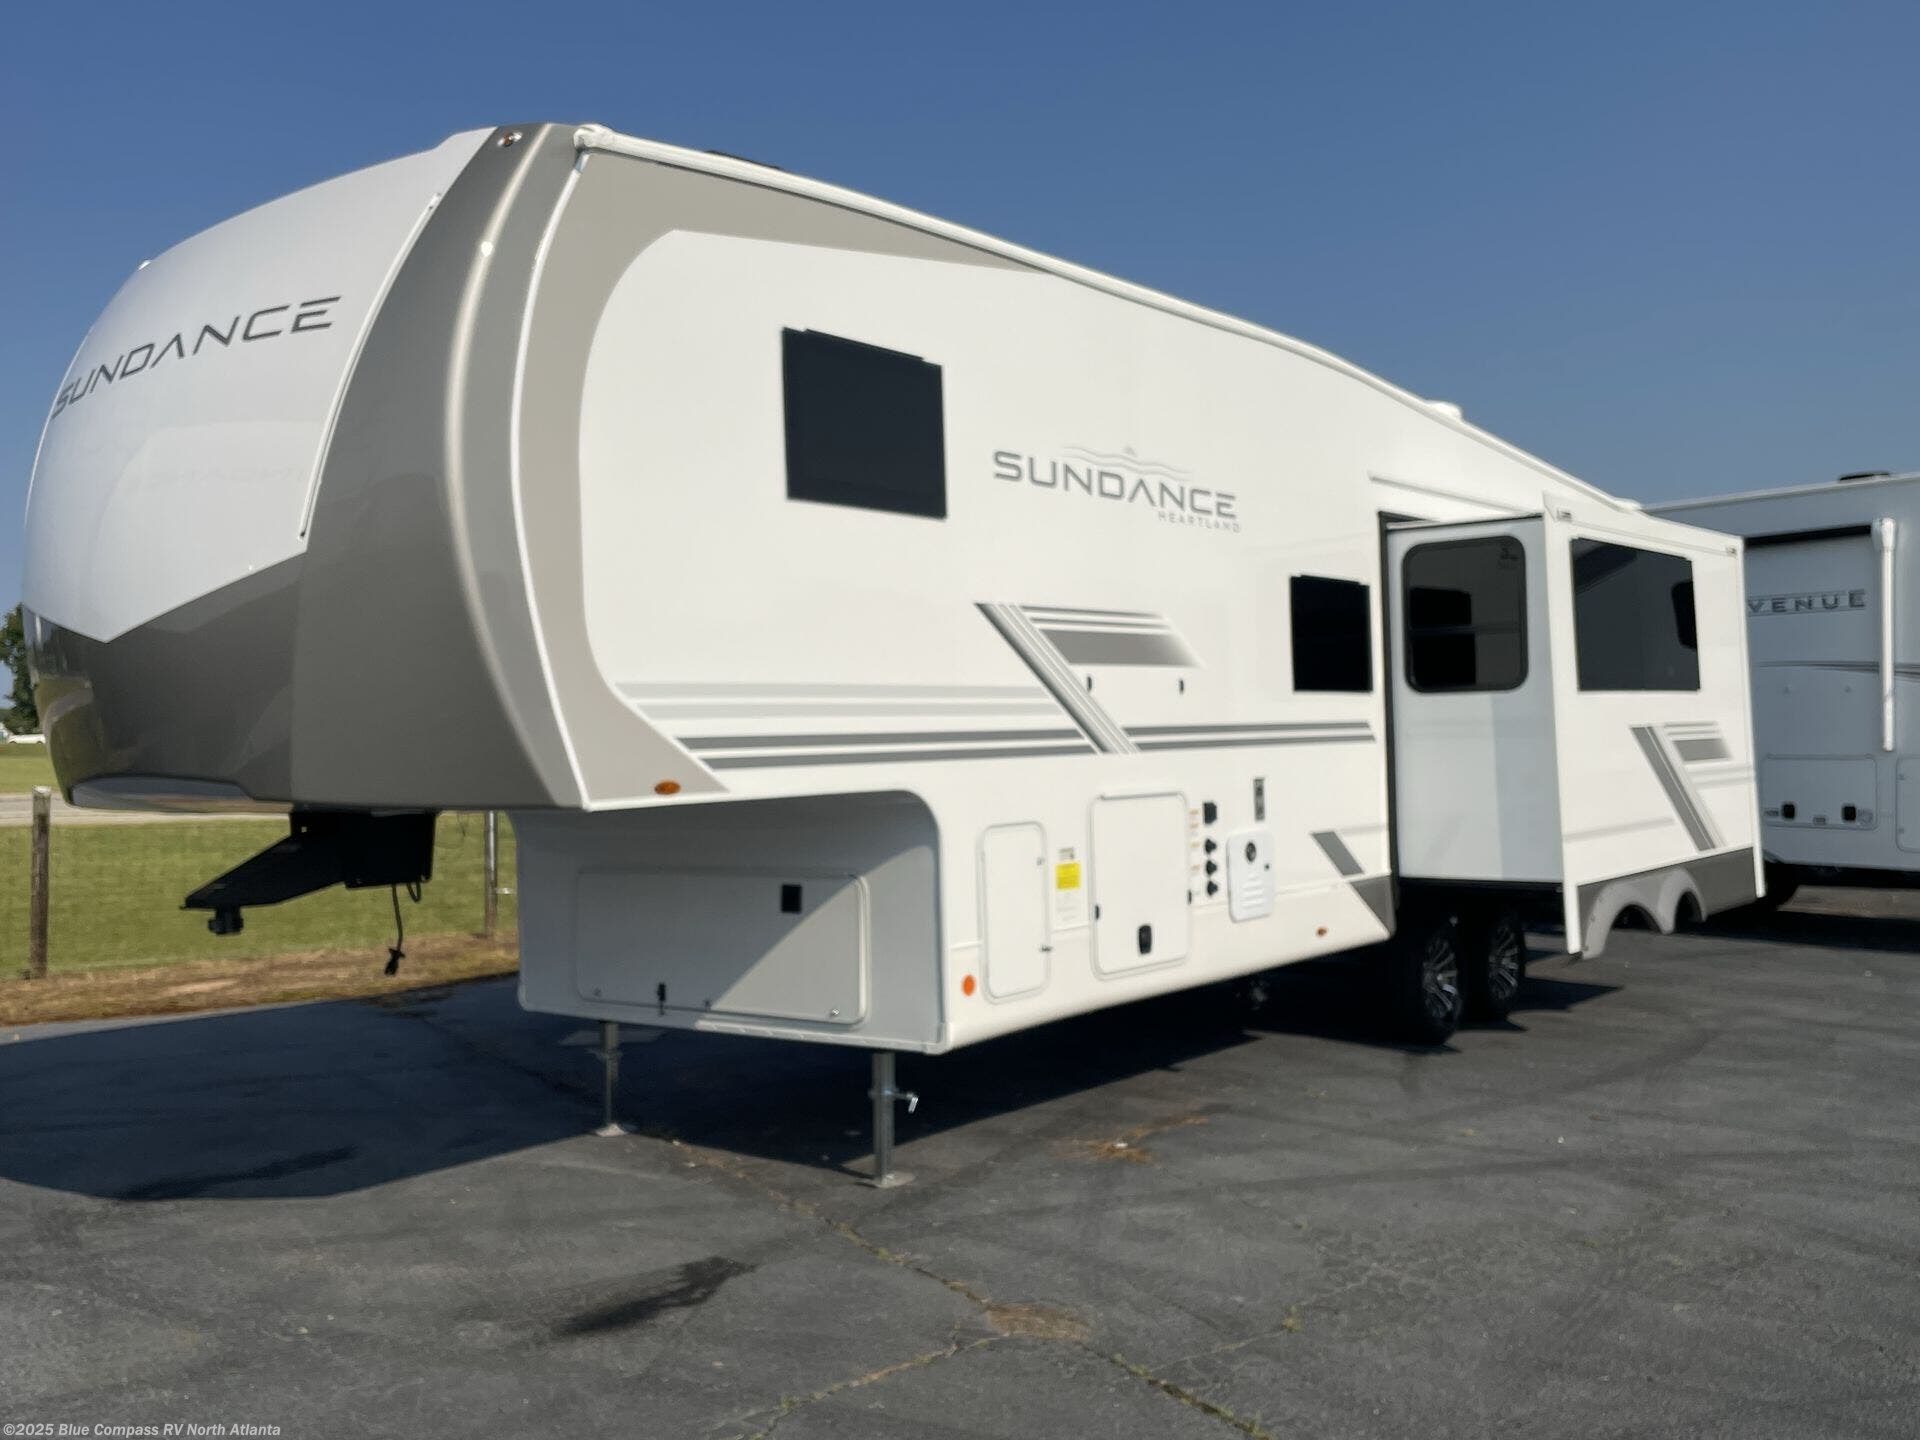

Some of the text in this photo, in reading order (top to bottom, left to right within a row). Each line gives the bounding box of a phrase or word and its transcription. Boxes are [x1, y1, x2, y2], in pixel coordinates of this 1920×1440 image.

[50, 296, 342, 420] SUNDANCE
[993, 450, 1237, 519] SUNDANCE
[1158, 510, 1241, 533] HEARTLAND
